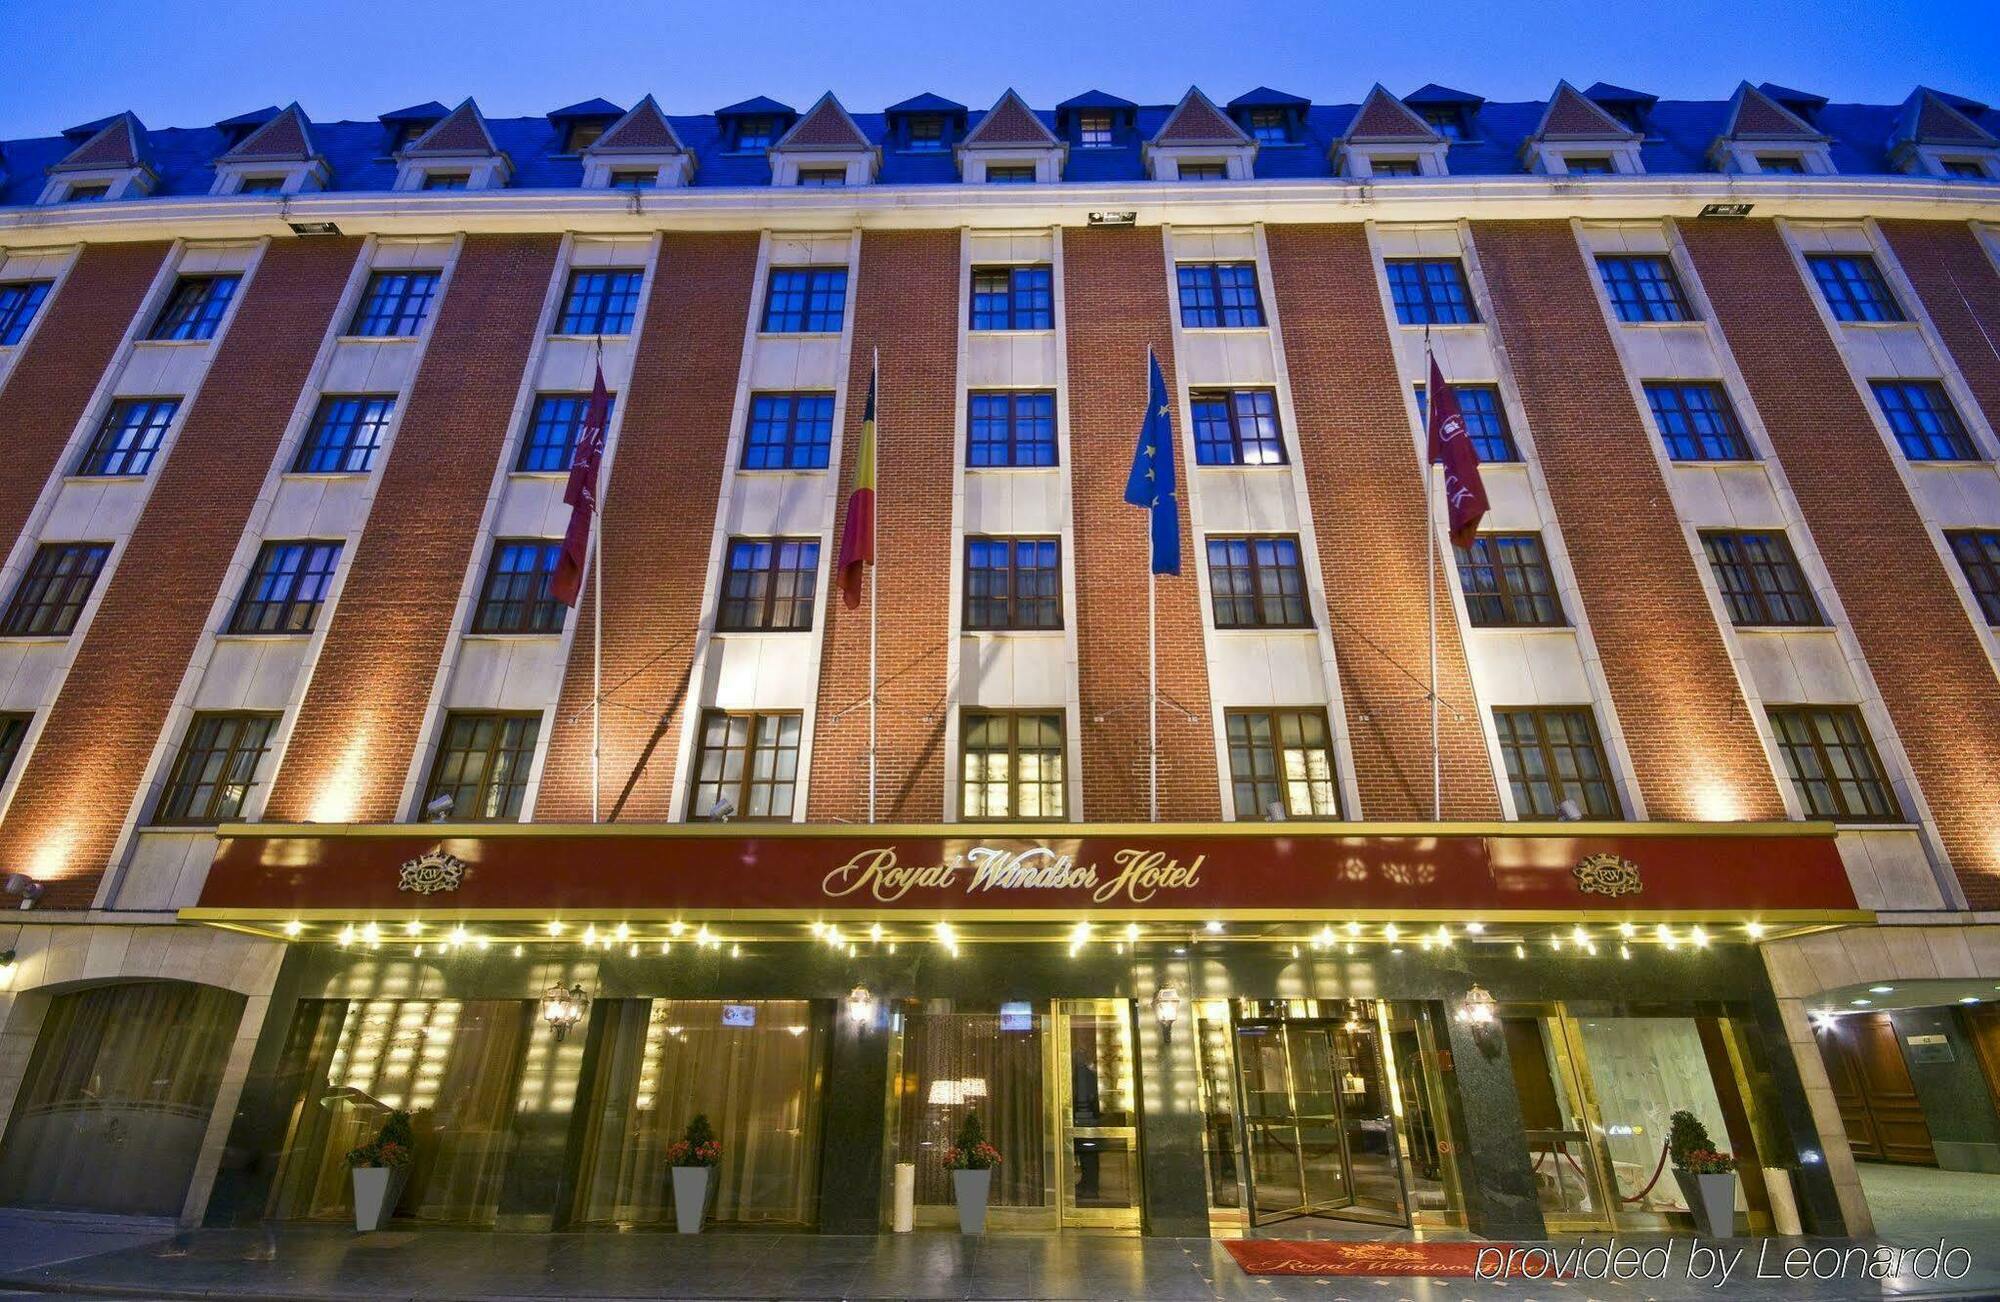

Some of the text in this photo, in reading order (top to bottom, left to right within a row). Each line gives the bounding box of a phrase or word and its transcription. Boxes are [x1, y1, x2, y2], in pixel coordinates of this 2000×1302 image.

[822, 846, 1206, 903] Royal Windsor Hotel
